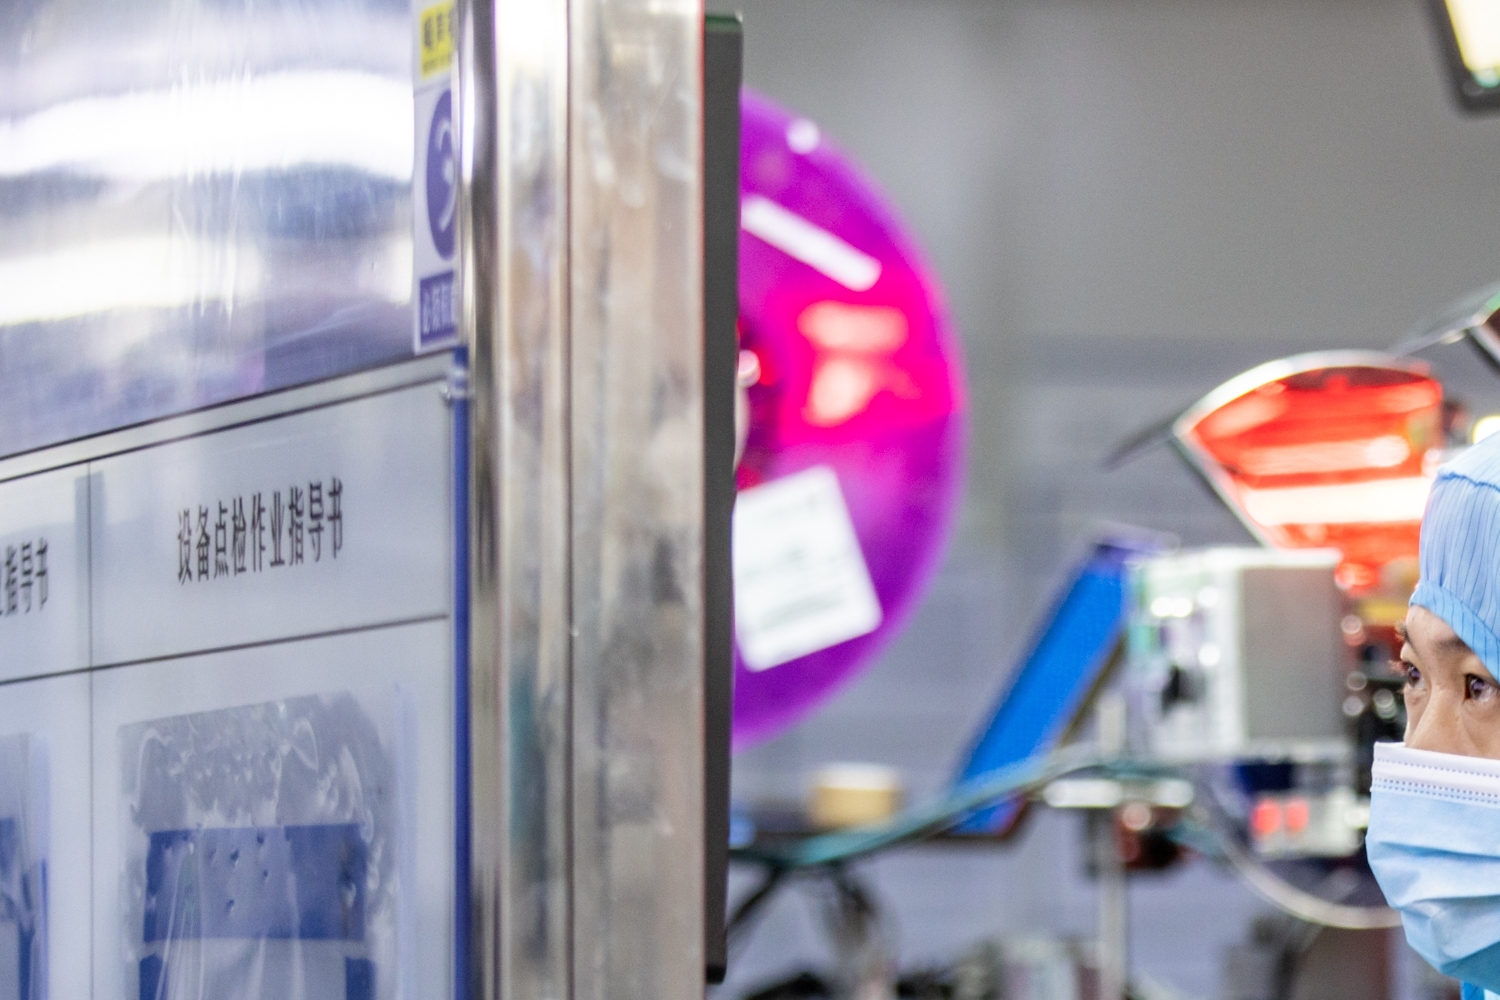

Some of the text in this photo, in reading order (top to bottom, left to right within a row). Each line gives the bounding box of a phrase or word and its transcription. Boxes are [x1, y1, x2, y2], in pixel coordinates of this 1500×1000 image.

[0, 537, 49, 617] 指导书
[177, 476, 343, 586] 设备点检作业指导书
